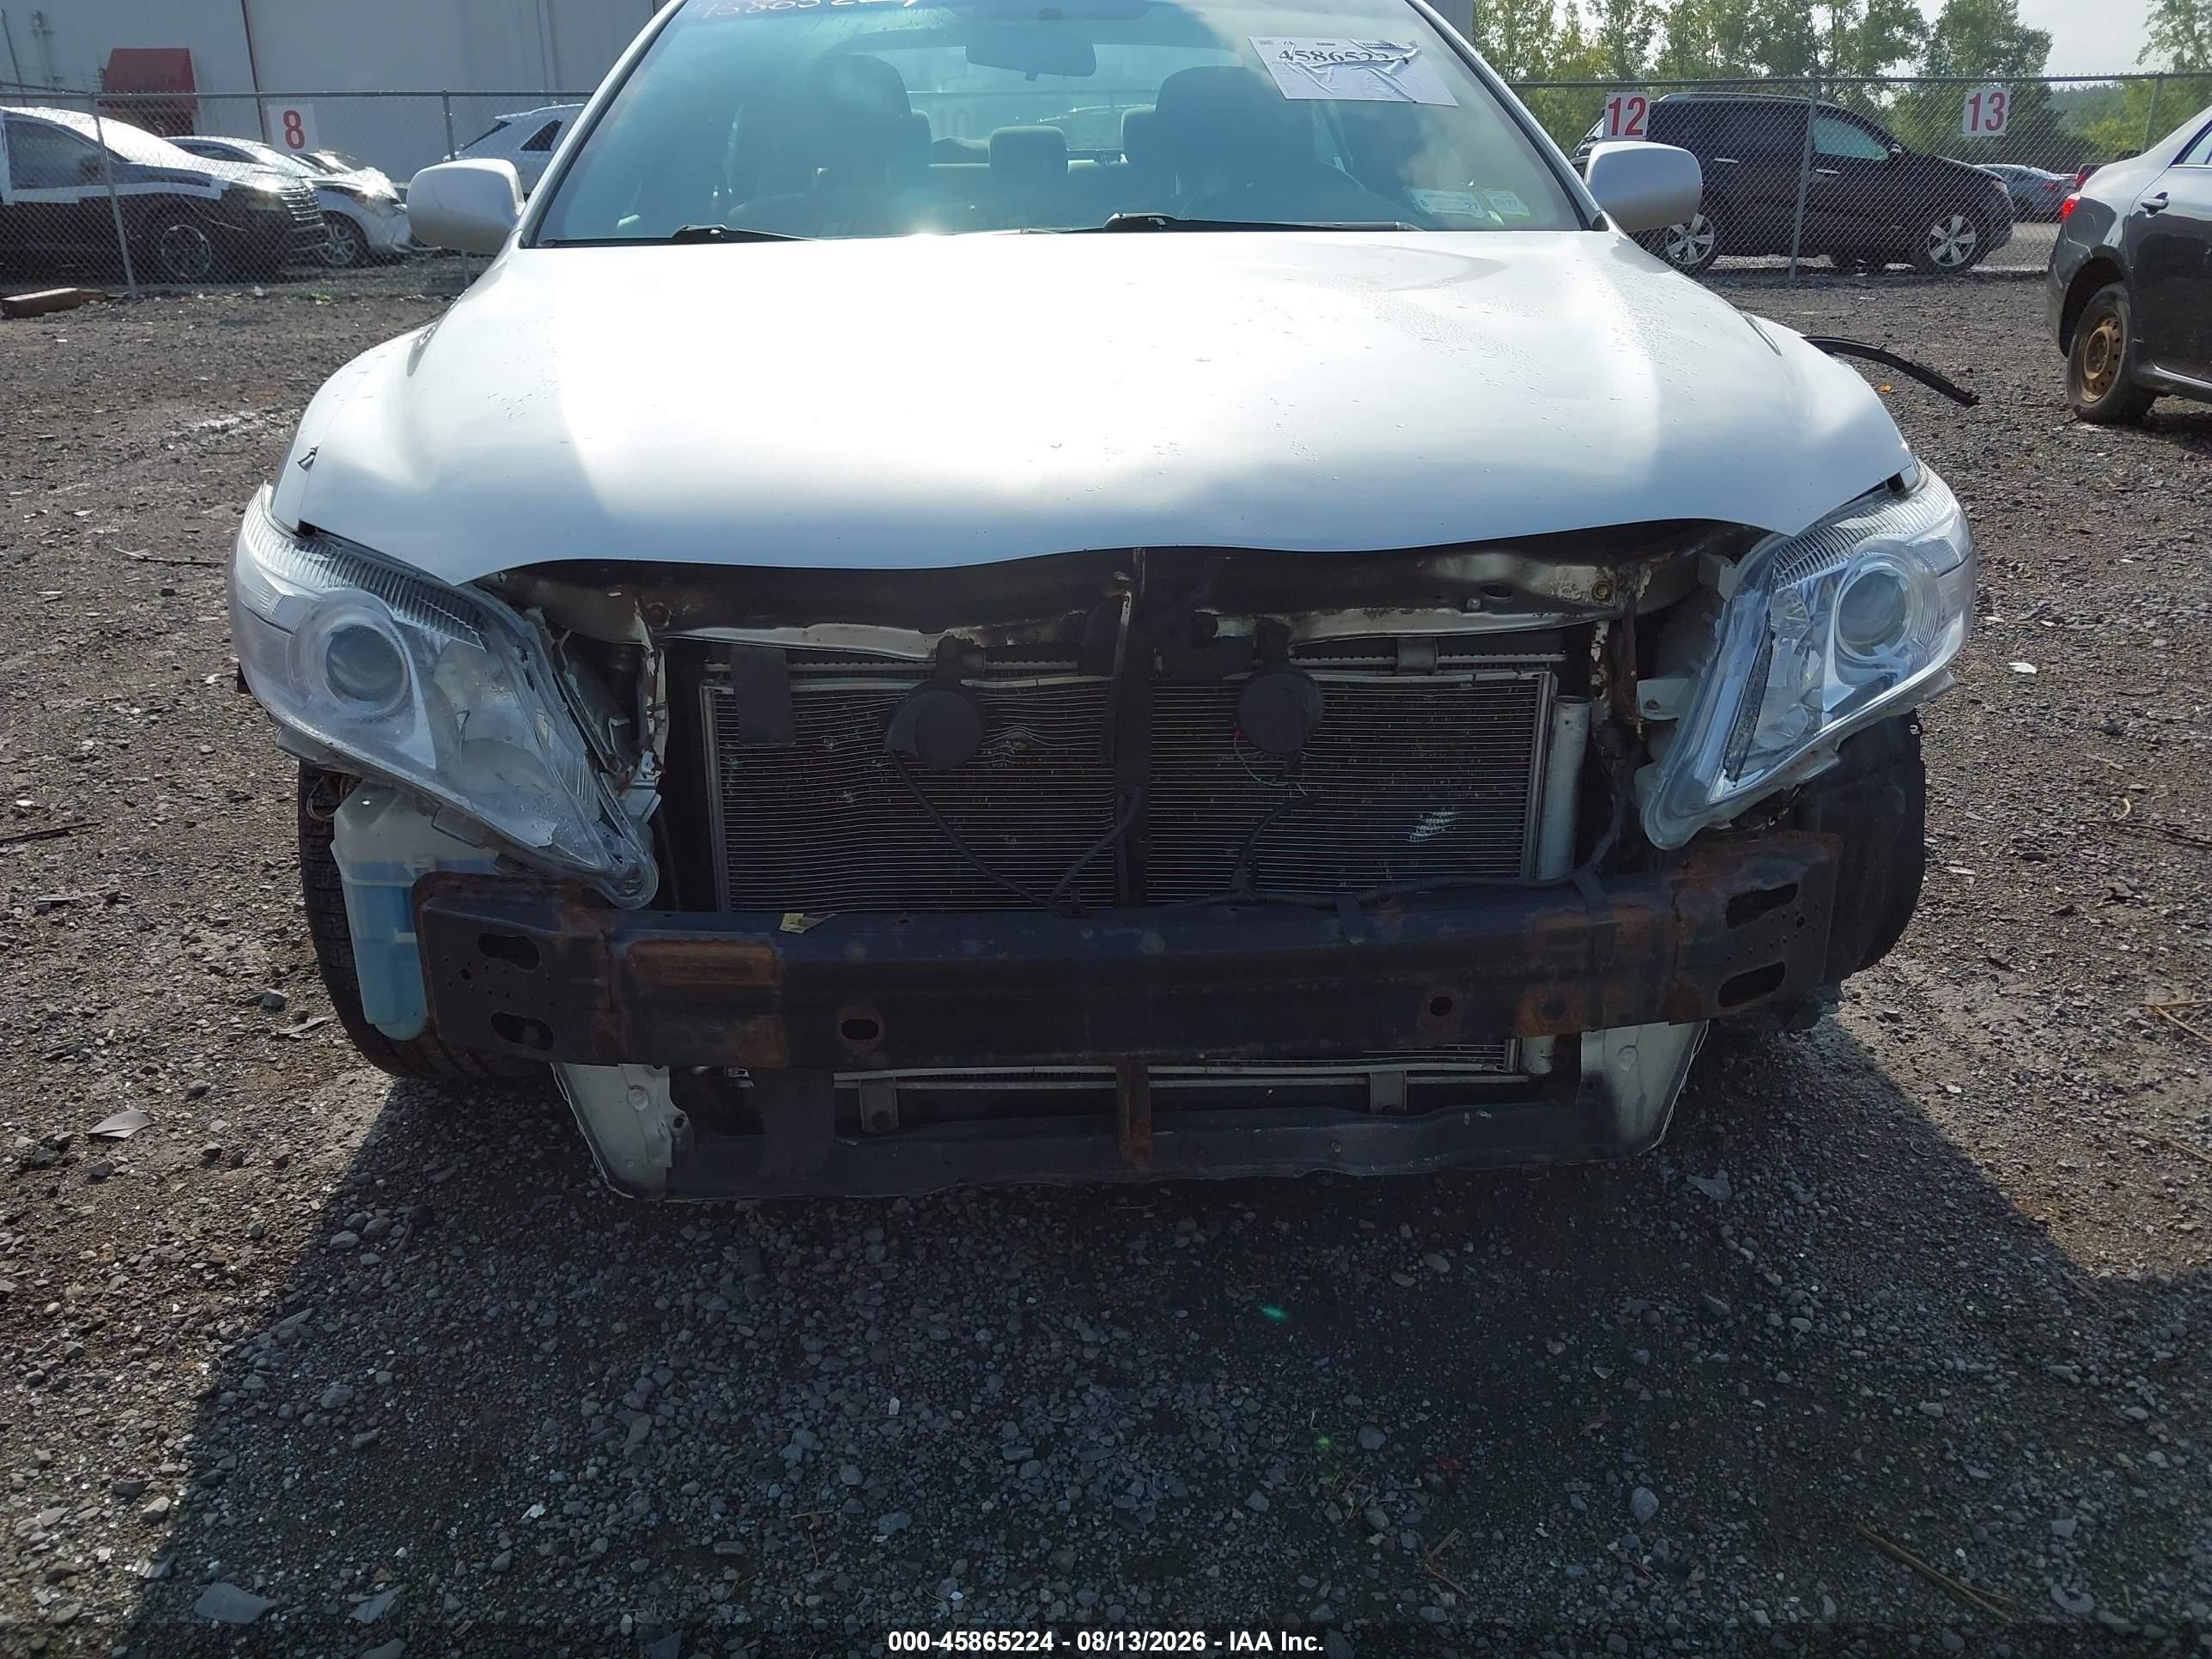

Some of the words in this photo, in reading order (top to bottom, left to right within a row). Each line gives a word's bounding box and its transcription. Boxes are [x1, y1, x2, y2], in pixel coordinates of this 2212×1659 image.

[283, 109, 305, 149] 8
[1608, 96, 1646, 137] 12
[1968, 92, 2006, 131] 13
